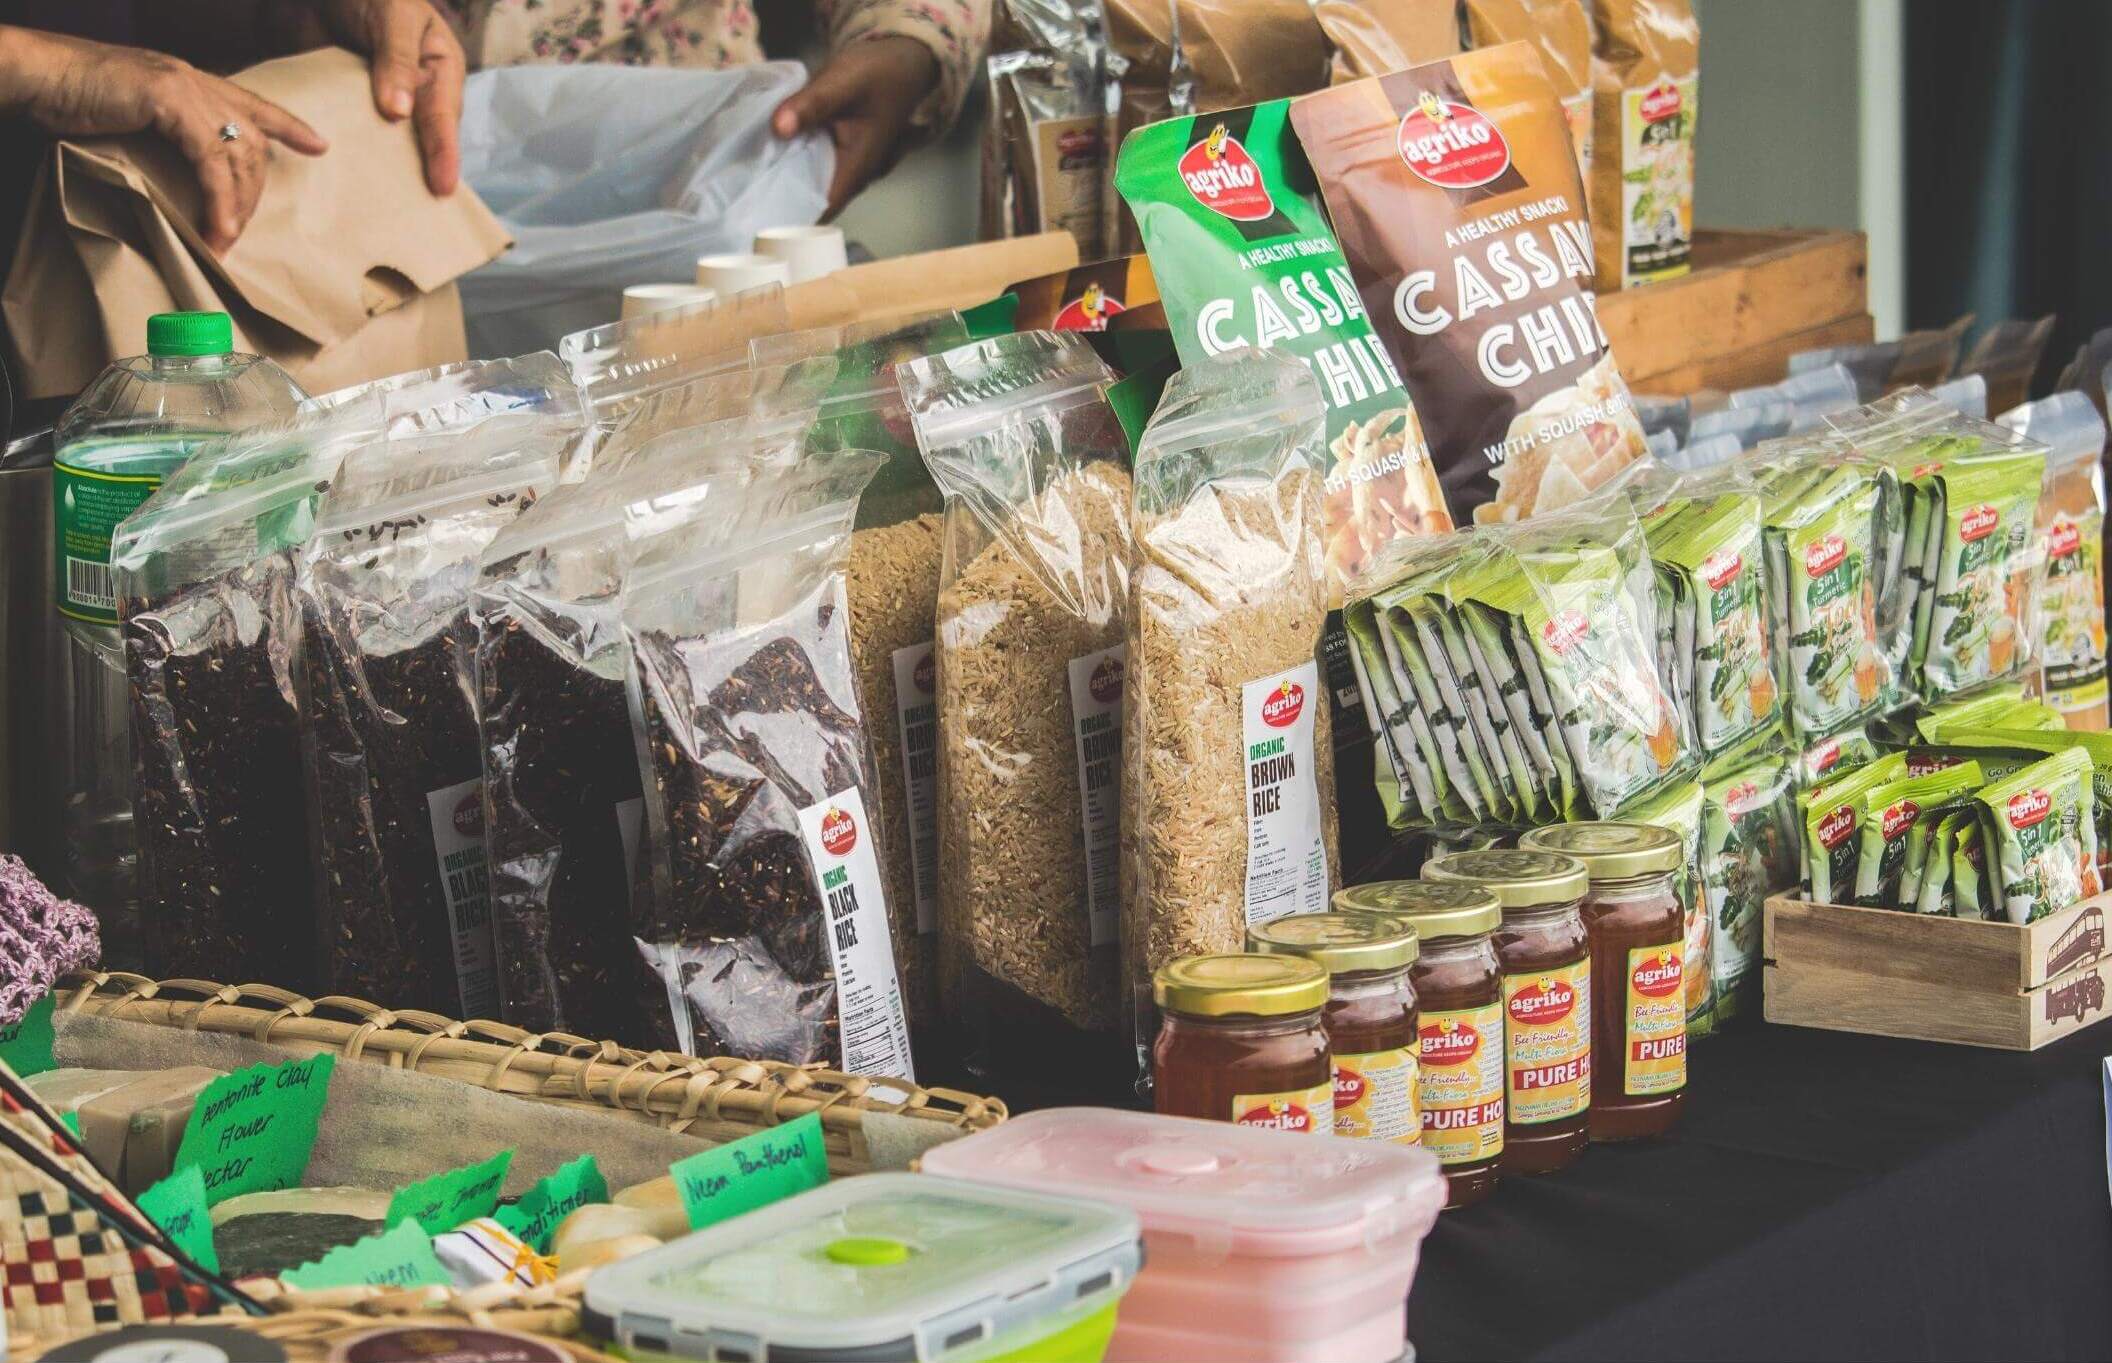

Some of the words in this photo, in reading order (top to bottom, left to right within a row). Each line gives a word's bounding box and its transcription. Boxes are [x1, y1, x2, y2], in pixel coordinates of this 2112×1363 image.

[1405, 121, 1490, 164] agriko
[1185, 159, 1254, 198] agriko
[1445, 231, 1458, 248] A
[1456, 209, 1521, 243] HEALTHY
[1520, 195, 1568, 222] SNACK!
[1238, 253, 1252, 270] A
[1247, 241, 1298, 268] HEALTHY
[1197, 265, 1366, 358] CASSA
[1483, 432, 1536, 464] WITH
[1538, 405, 1604, 444] SQUASH
[1349, 450, 1408, 485] SQUASH
[1961, 512, 1997, 534] agriko
[1264, 691, 1303, 716] agriko
[1250, 737, 1285, 761] ORGANIC
[1251, 752, 1295, 789] BROWN
[1252, 786, 1281, 818] RICE
[2010, 797, 2048, 819] agriko
[822, 819, 853, 843] agriko
[1819, 814, 1851, 841] agriko
[828, 883, 859, 920] BLACK
[834, 917, 858, 951] RICE
[1634, 964, 1681, 983] agriko
[1510, 991, 1571, 1014] agriko
[1422, 1033, 1475, 1052] griko
[1514, 1034, 1529, 1046] Bee
[1639, 1035, 1683, 1060] PURE
[1523, 1061, 1578, 1089] PURE
[1421, 1106, 1479, 1130] PURE
[218, 1115, 274, 1153] Flower
[205, 1157, 253, 1190] ectar
[685, 1176, 729, 1205] Neem
